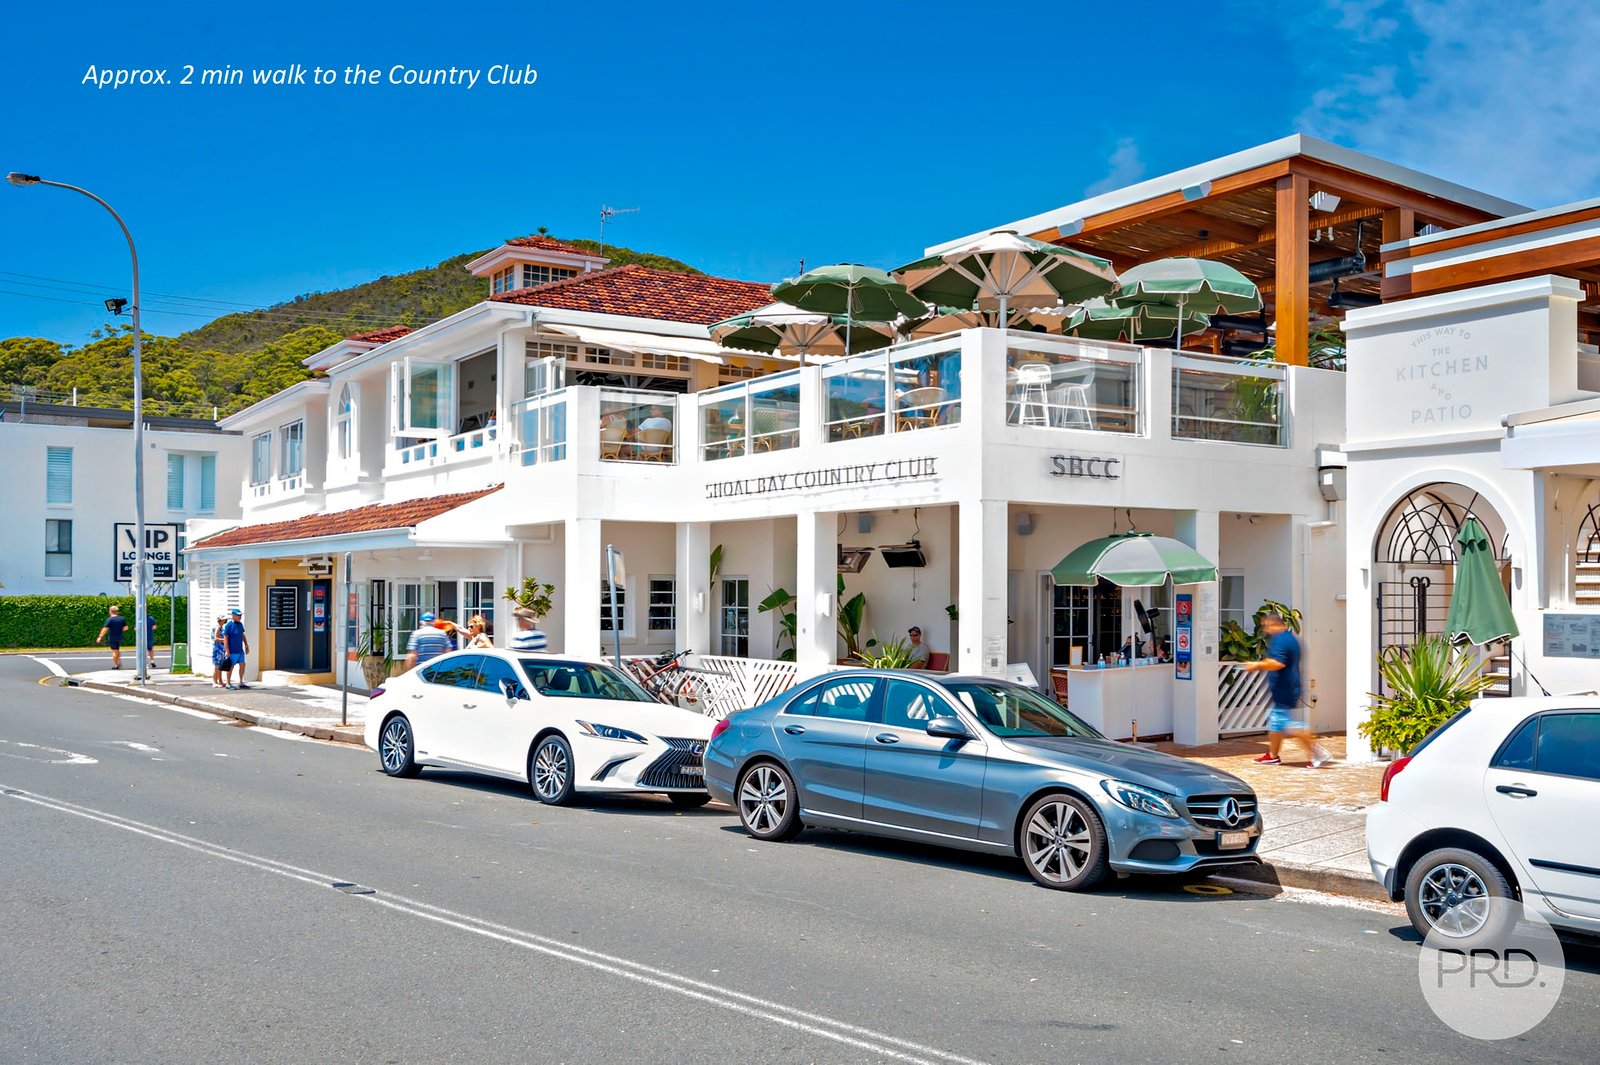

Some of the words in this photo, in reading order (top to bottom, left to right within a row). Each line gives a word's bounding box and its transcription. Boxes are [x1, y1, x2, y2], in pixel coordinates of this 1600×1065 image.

[1411, 331, 1432, 348] THIS
[1434, 327, 1456, 337] WAY
[1458, 328, 1471, 340] TO
[1432, 346, 1451, 356] THE
[1396, 355, 1488, 382] KITCHEN
[1411, 404, 1472, 424] PATIO
[706, 479, 752, 499] SHOAL
[758, 473, 788, 494] BAY
[794, 462, 877, 489] COUNTRY
[884, 455, 936, 481] CLUB
[1052, 454, 1119, 481] SBCC
[122, 551, 171, 561] LONGE
